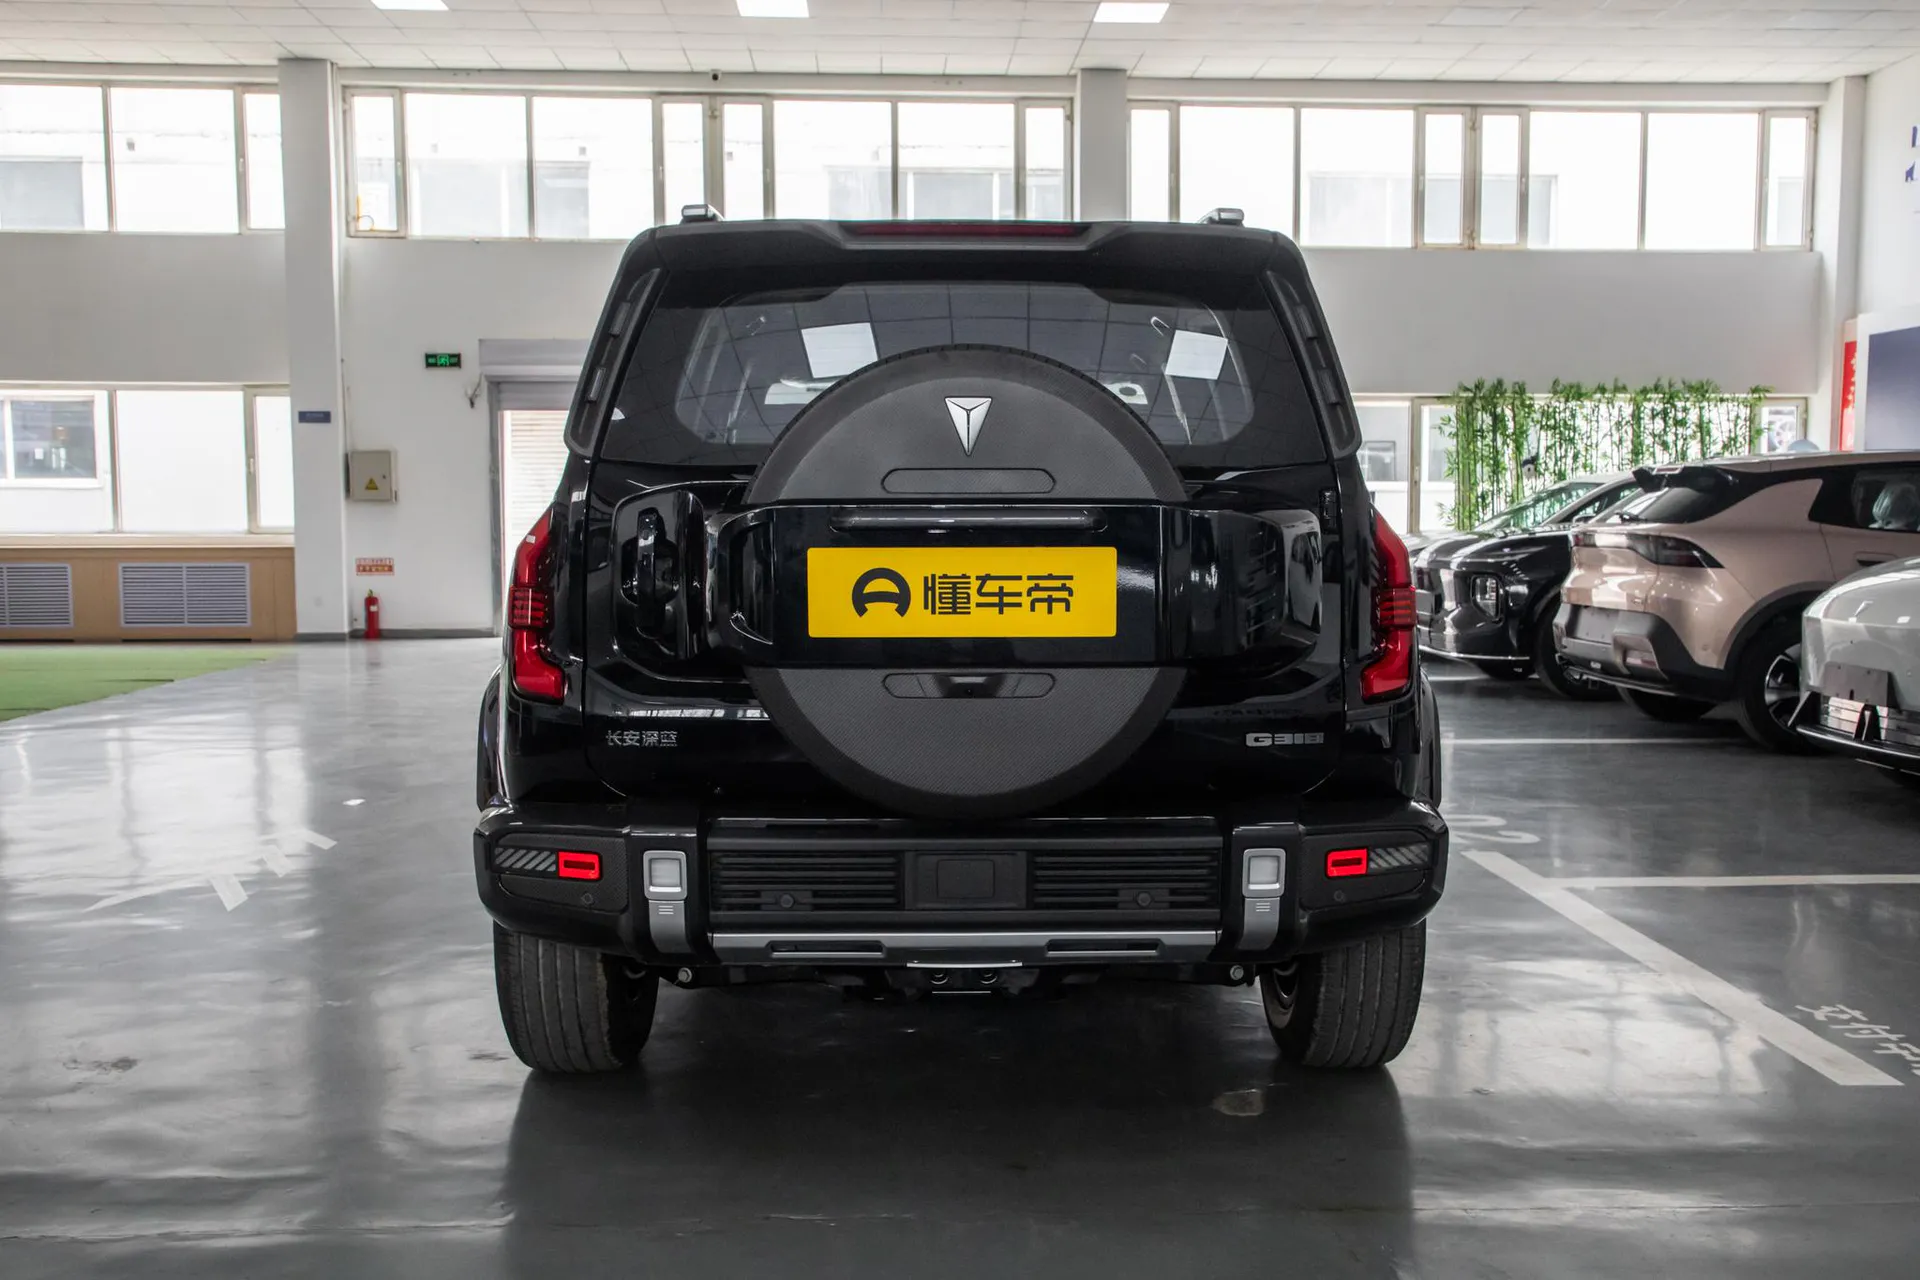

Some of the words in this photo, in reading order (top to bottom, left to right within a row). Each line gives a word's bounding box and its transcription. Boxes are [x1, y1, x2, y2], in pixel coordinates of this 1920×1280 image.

[923, 573, 1074, 615] 懂车帝
[605, 730, 678, 747] 长安深蓝
[1245, 732, 1324, 747] G318
